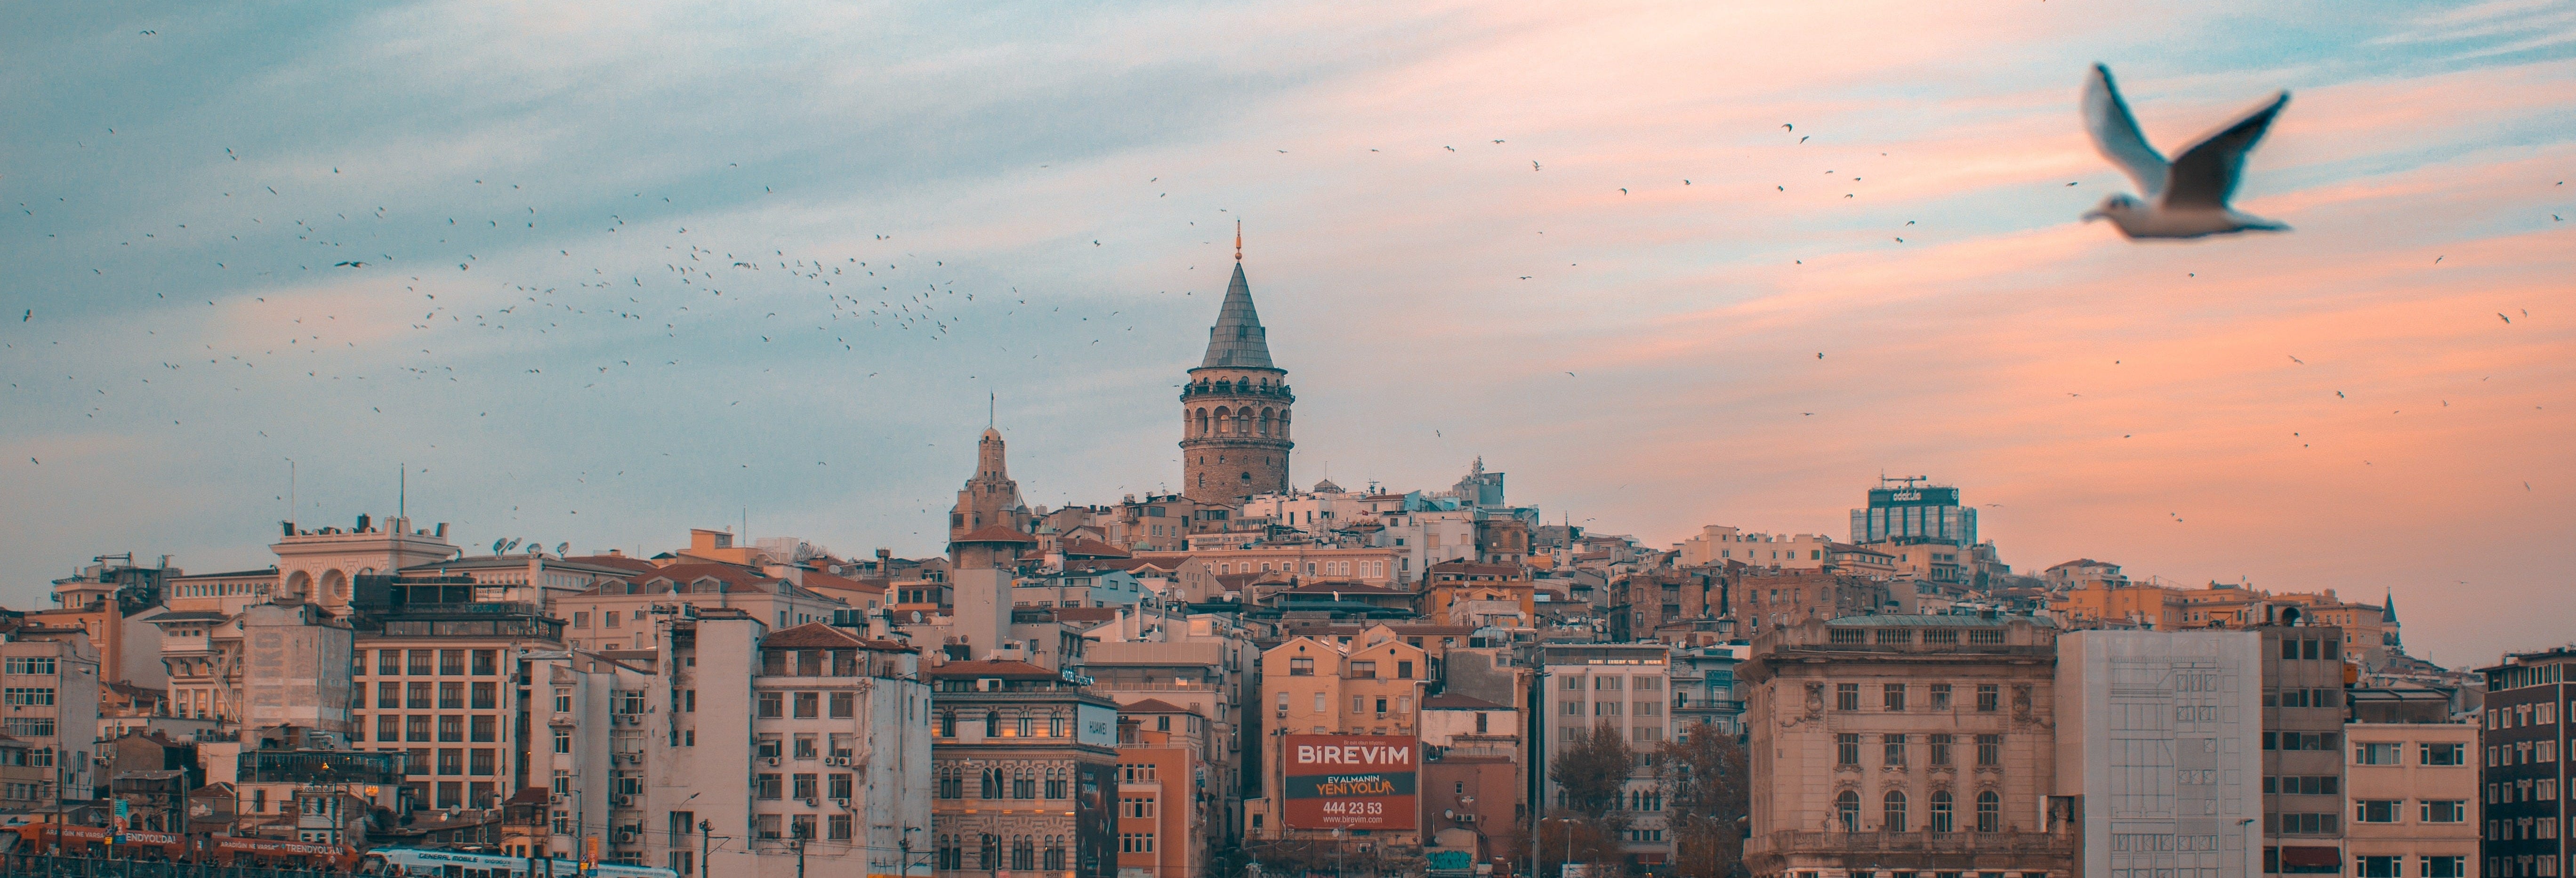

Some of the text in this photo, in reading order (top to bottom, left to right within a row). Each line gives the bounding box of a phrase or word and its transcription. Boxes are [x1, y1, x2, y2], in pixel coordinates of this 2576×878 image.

[1062, 669, 1074, 682] HOTEL
[1089, 721, 1107, 735] HUAWEI
[1340, 775, 1379, 783] ALMANIN
[1323, 802, 1382, 814] 444 23 53
[46, 828, 74, 837] ARAIĞIN
[126, 832, 176, 844] ENDYOL'DA!
[419, 853, 451, 861] GENERAL
